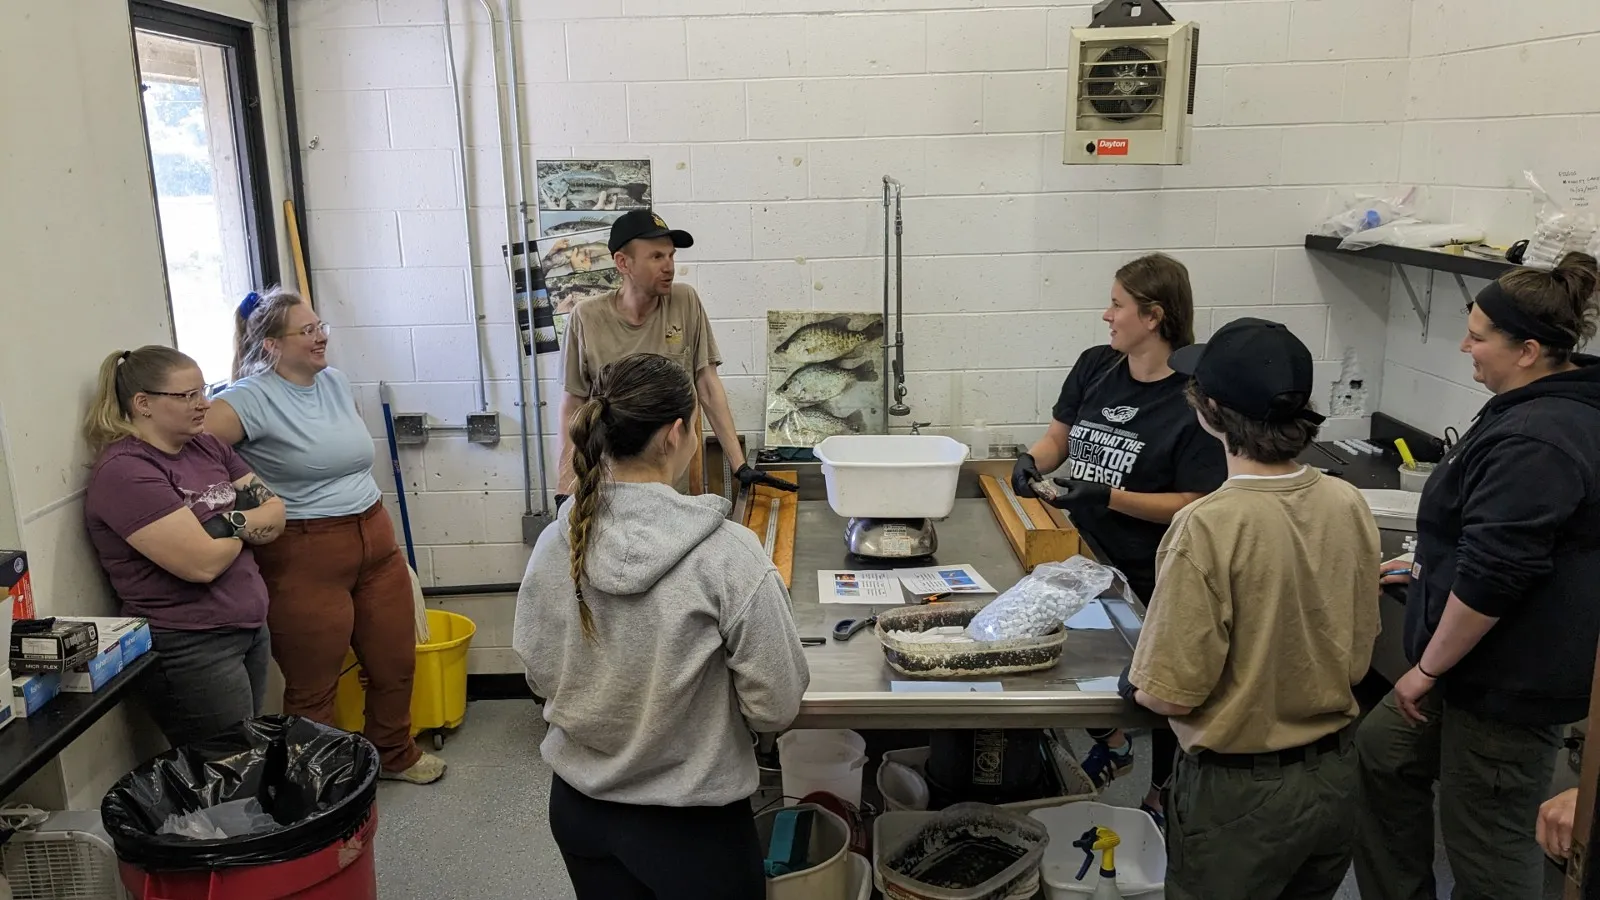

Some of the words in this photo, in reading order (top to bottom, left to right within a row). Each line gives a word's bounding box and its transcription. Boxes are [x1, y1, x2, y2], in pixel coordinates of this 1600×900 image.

[1099, 140, 1126, 148] Dayton
[1089, 429, 1124, 448] WHAT
[1124, 438, 1146, 454] THE
